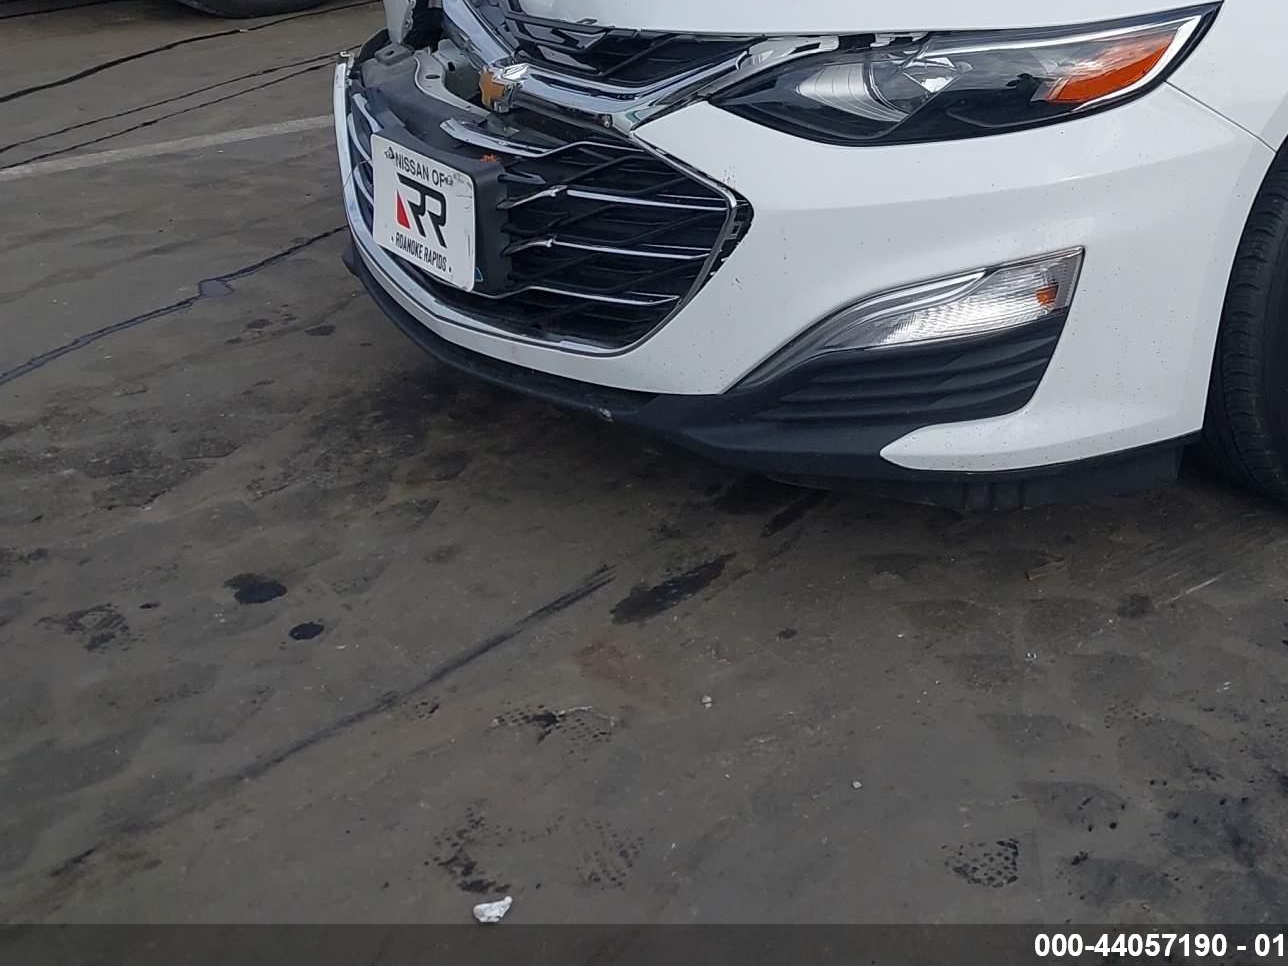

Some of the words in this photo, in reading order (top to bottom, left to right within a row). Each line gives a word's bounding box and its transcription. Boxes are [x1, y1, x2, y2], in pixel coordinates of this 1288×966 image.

[395, 151, 430, 182] NISSAN
[431, 169, 445, 188] OF
[395, 231, 424, 260] ROANOKE
[423, 246, 447, 273] RAPIDS
